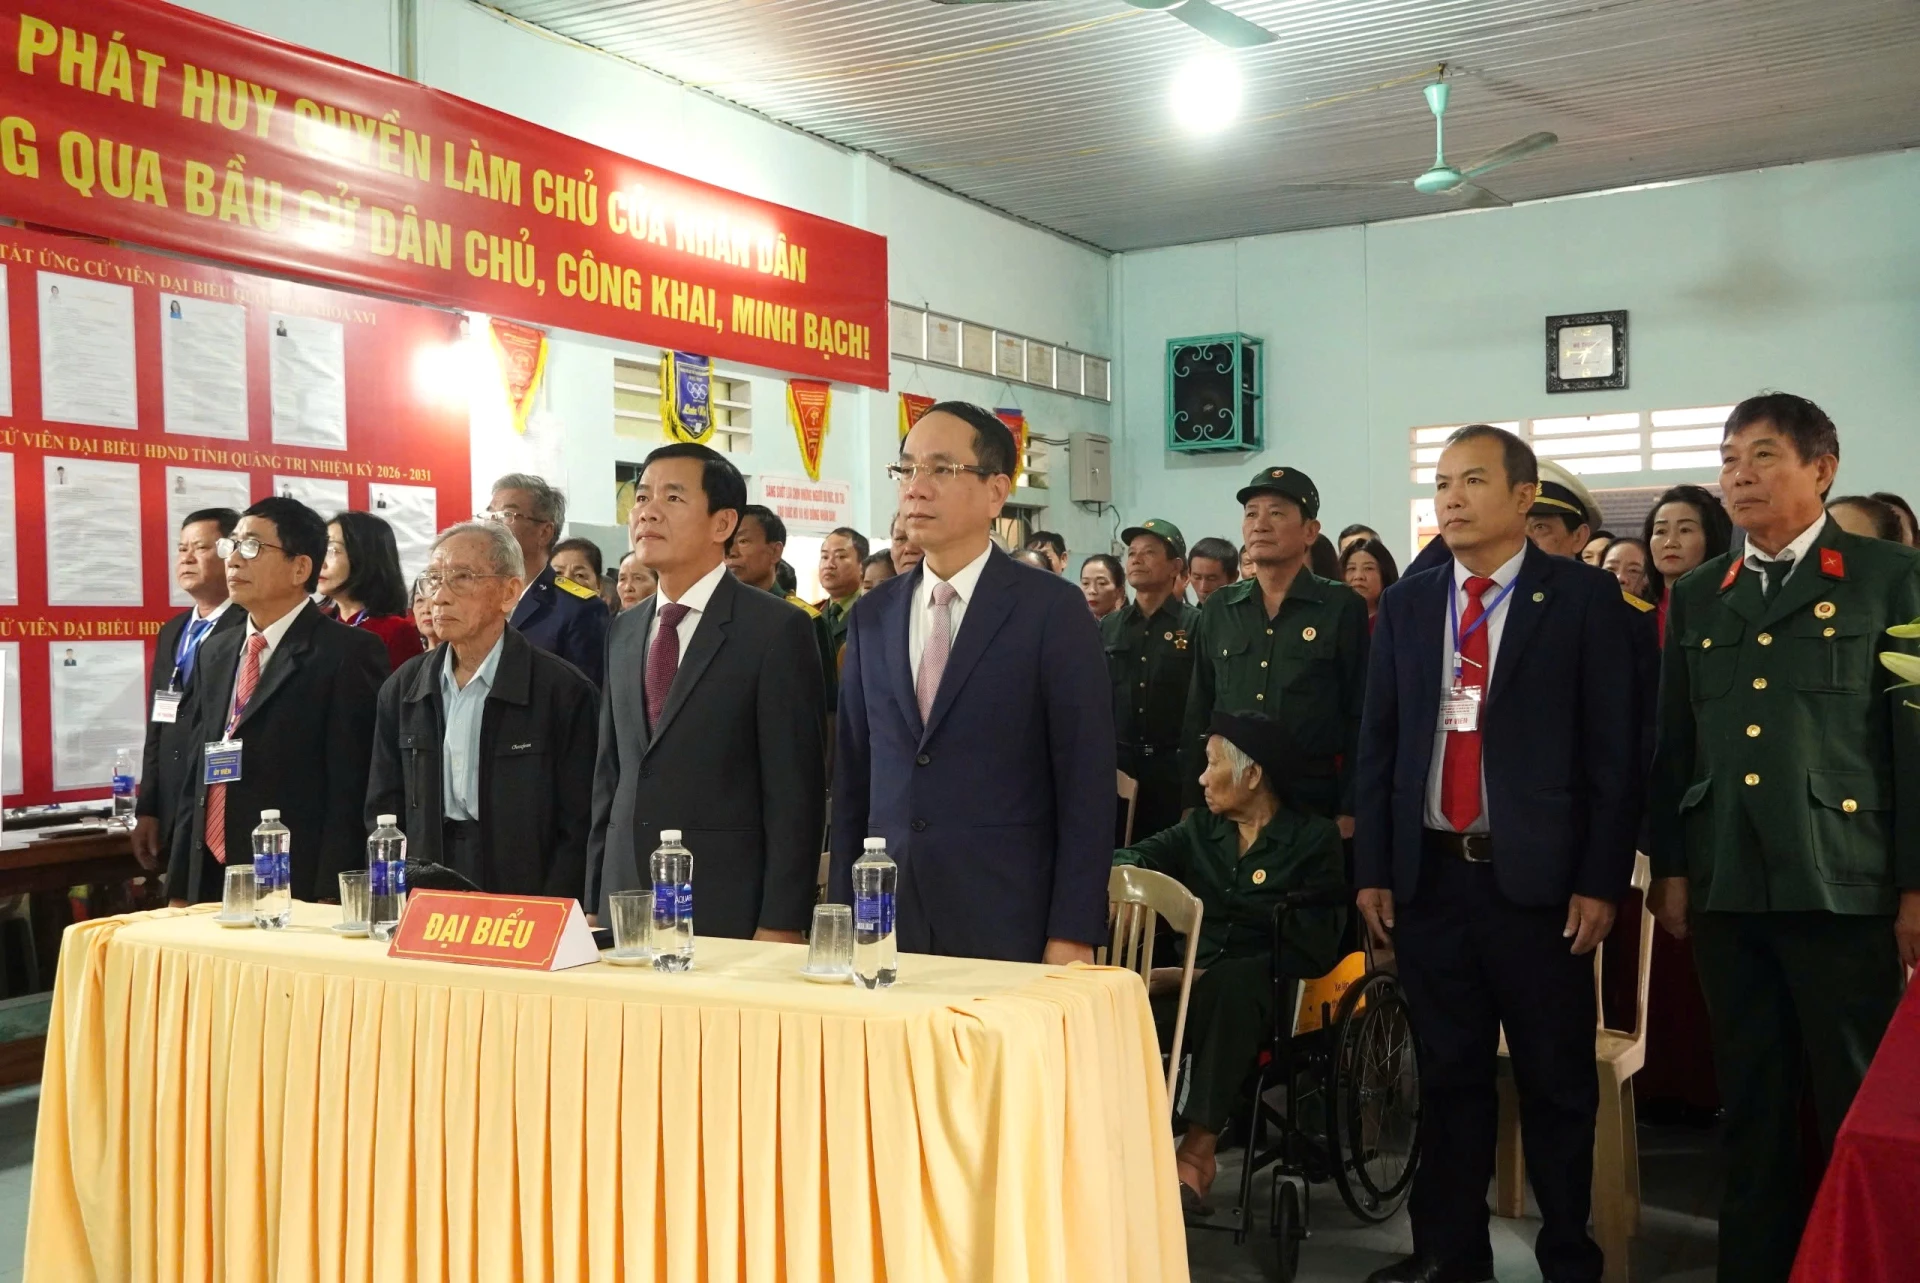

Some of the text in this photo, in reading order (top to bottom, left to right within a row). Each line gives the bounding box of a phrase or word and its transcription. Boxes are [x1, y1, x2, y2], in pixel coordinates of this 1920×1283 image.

[18, 13, 167, 109] PHÁT
[181, 63, 278, 138] HUY
[293, 98, 430, 182] QUYỀN
[444, 139, 521, 206] LÀM
[533, 168, 598, 227] CHỦ
[607, 182, 668, 247] CỦA
[756, 232, 807, 283] DÂN
[59, 130, 168, 208] QUA
[185, 153, 282, 232] BẦU
[297, 181, 361, 249] CỬ
[370, 204, 451, 270] DÂN
[465, 227, 546, 296] CHỦ,
[556, 250, 642, 311] CÔNG
[651, 275, 723, 334] KHAI,
[732, 294, 797, 345] MINH
[804, 312, 870, 360] BẠCH!
[39, 248, 79, 272] ỨNG
[84, 258, 112, 277] CỬ
[114, 265, 155, 285] VIÊN
[160, 274, 188, 294] ĐẠI
[22, 430, 64, 450] VIÊN
[69, 436, 98, 456] ĐẠI
[103, 438, 140, 456] BIỂU
[145, 443, 188, 461] HĐND
[191, 445, 228, 464] TỈNH
[231, 450, 282, 469] QUẢNG
[284, 456, 307, 475] TRỊ
[310, 459, 354, 477] NHIỆM
[357, 460, 374, 477] KỲ
[377, 465, 400, 480] 2026
[409, 468, 432, 482] 2031
[18, 617, 59, 636] VIÊN
[64, 621, 92, 640] ĐẠI
[95, 618, 134, 636] BIỂU
[139, 621, 165, 636] HĐ
[423, 907, 535, 949] ĐẠI BIỂU
